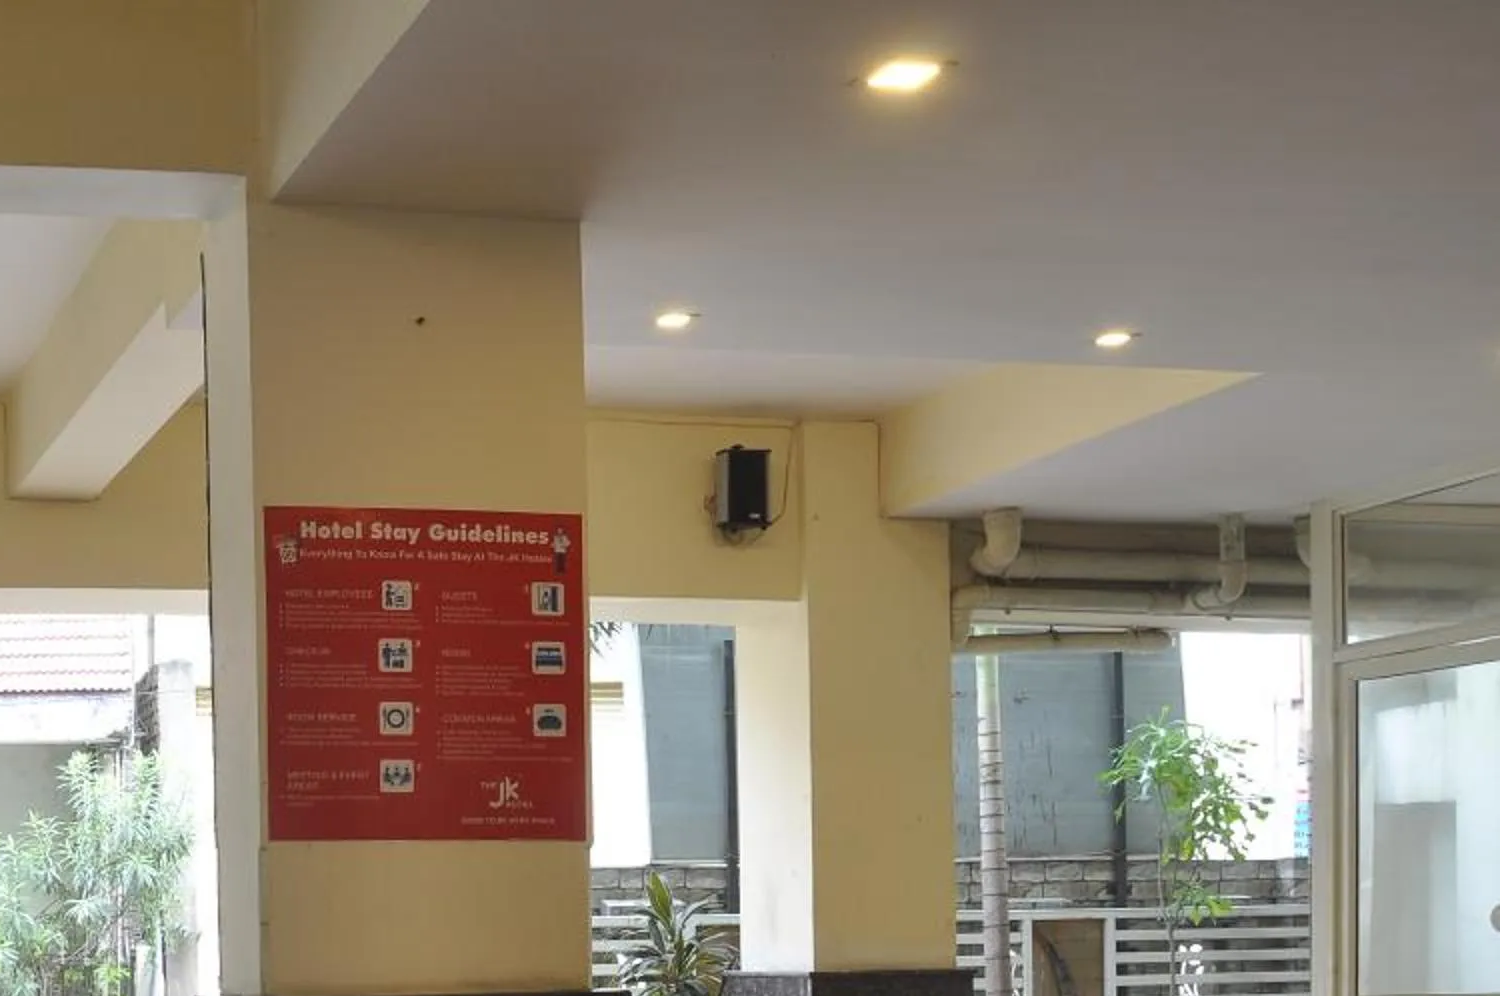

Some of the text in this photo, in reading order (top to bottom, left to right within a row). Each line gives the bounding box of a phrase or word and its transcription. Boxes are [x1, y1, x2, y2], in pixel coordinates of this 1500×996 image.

[300, 520, 549, 545] Hotel Stay Guidelines
